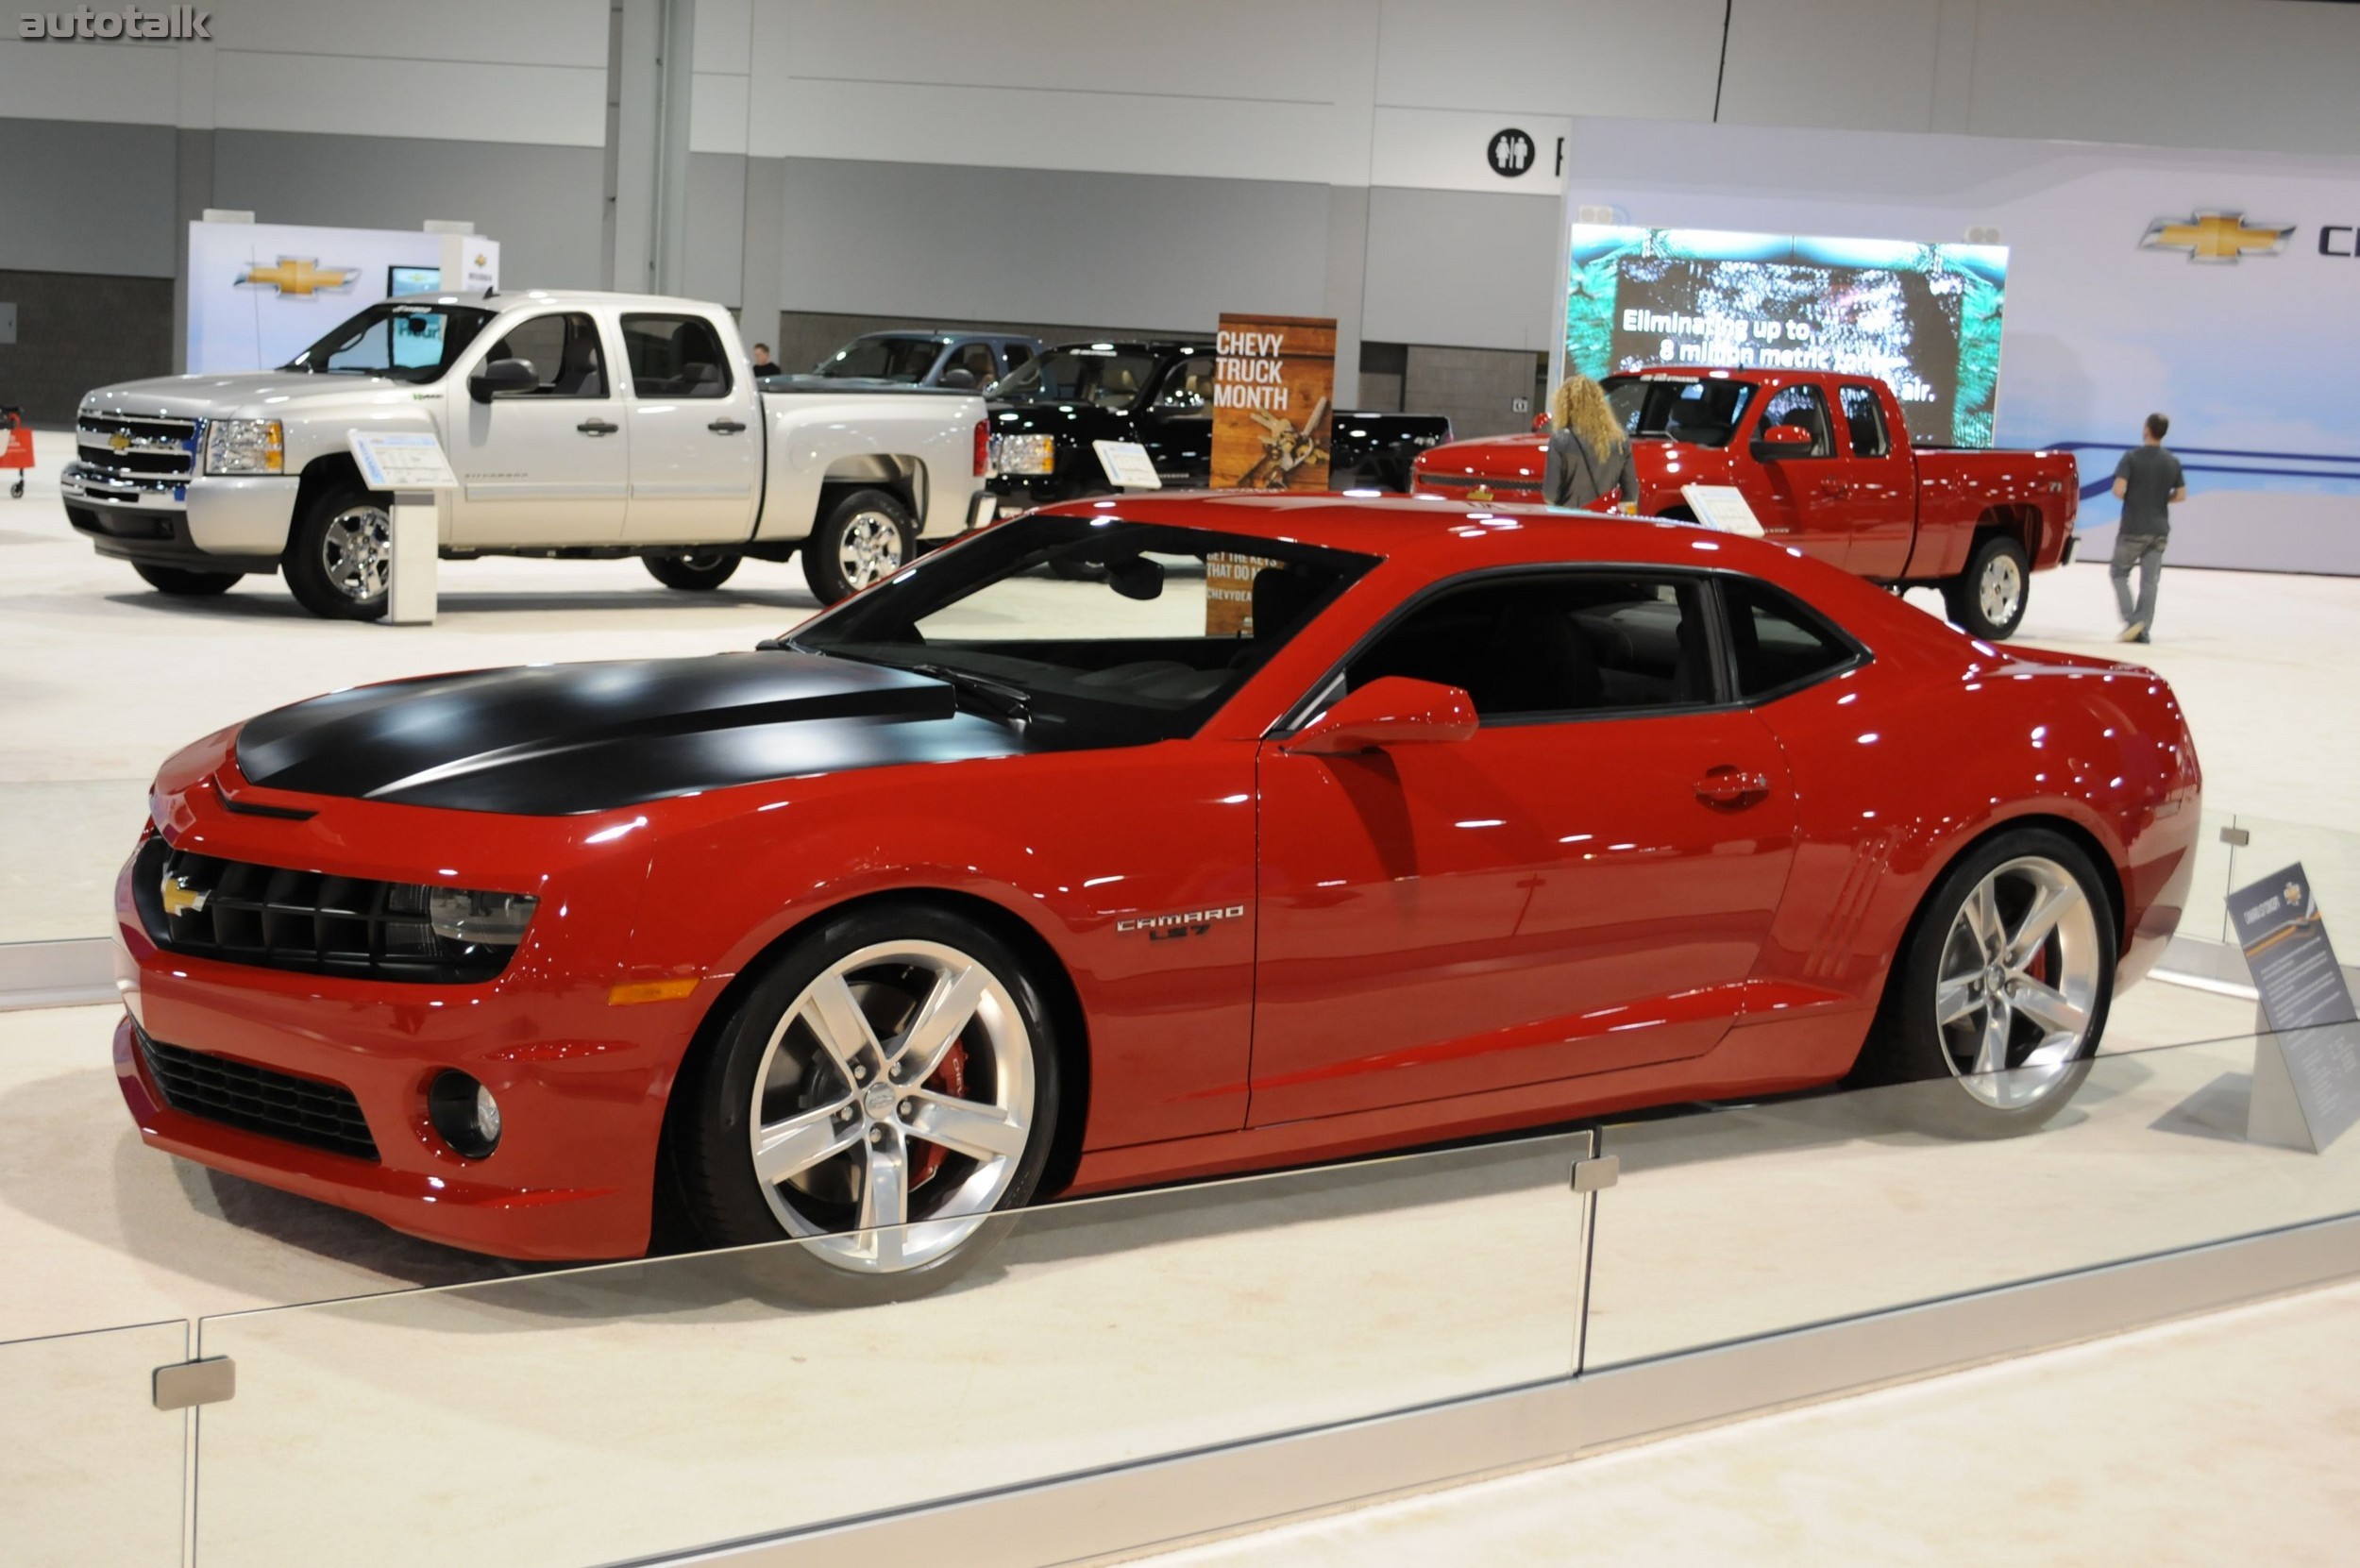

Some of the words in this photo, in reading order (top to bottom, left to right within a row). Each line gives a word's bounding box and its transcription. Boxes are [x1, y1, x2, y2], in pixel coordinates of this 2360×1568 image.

[1215, 330, 1284, 358] CHEVY
[1753, 319, 1781, 344] up
[1660, 339, 1675, 361] 8
[1215, 357, 1284, 385] TRUCK
[1213, 383, 1289, 411] MONTH
[1206, 563, 1232, 579] THAT
[1233, 565, 1250, 582] DO
[1206, 587, 1254, 602] CHEVYDEA
[1117, 905, 1244, 932] CAMARO
